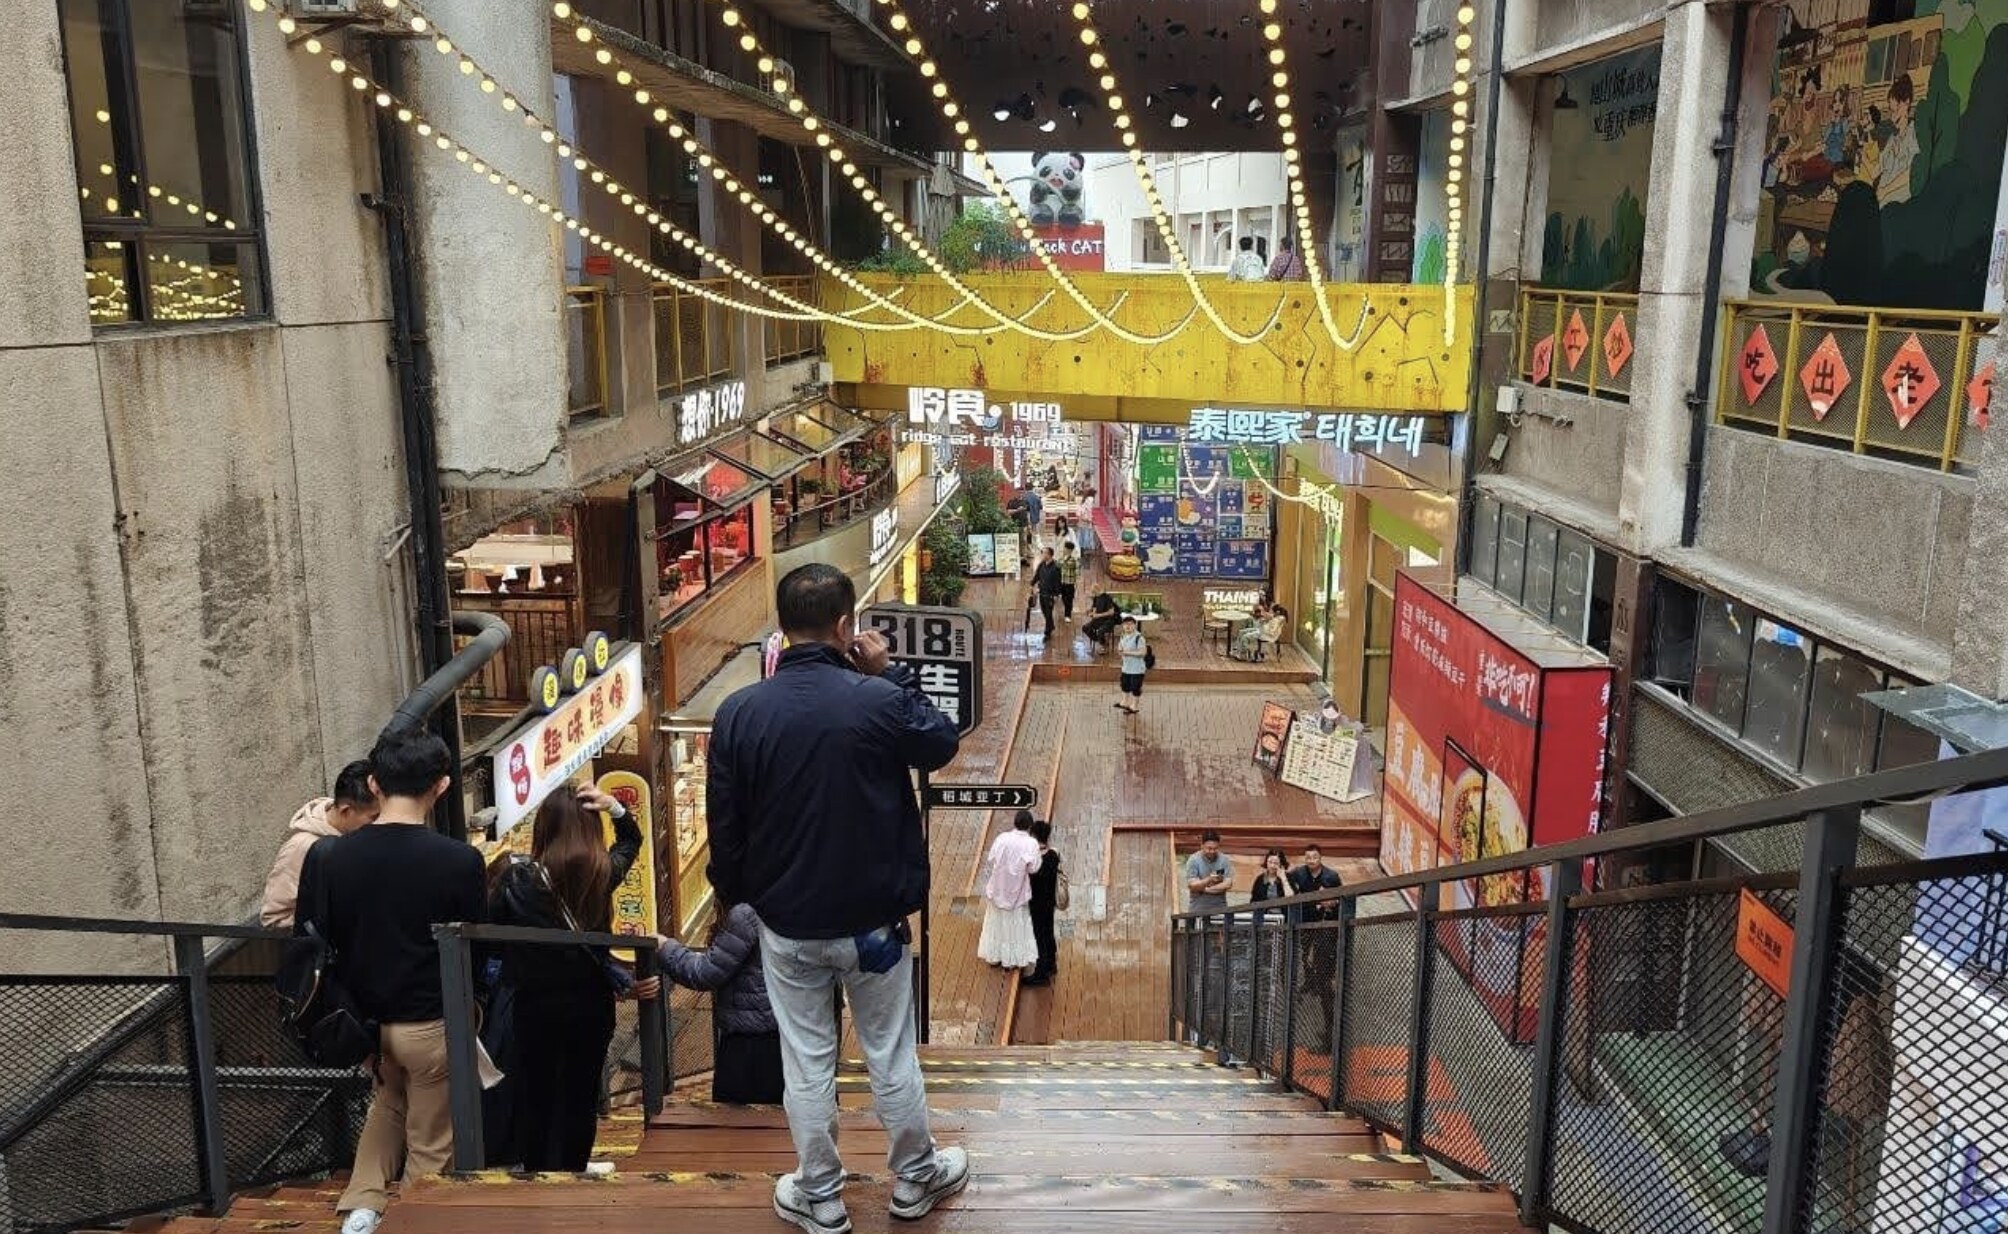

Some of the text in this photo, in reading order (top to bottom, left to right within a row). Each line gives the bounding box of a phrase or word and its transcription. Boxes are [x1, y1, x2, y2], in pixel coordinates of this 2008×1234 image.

[1071, 239, 1102, 254] CAT
[1009, 401, 1062, 422] 1969
[871, 614, 952, 656] 318
[955, 628, 966, 658] ROUTE
